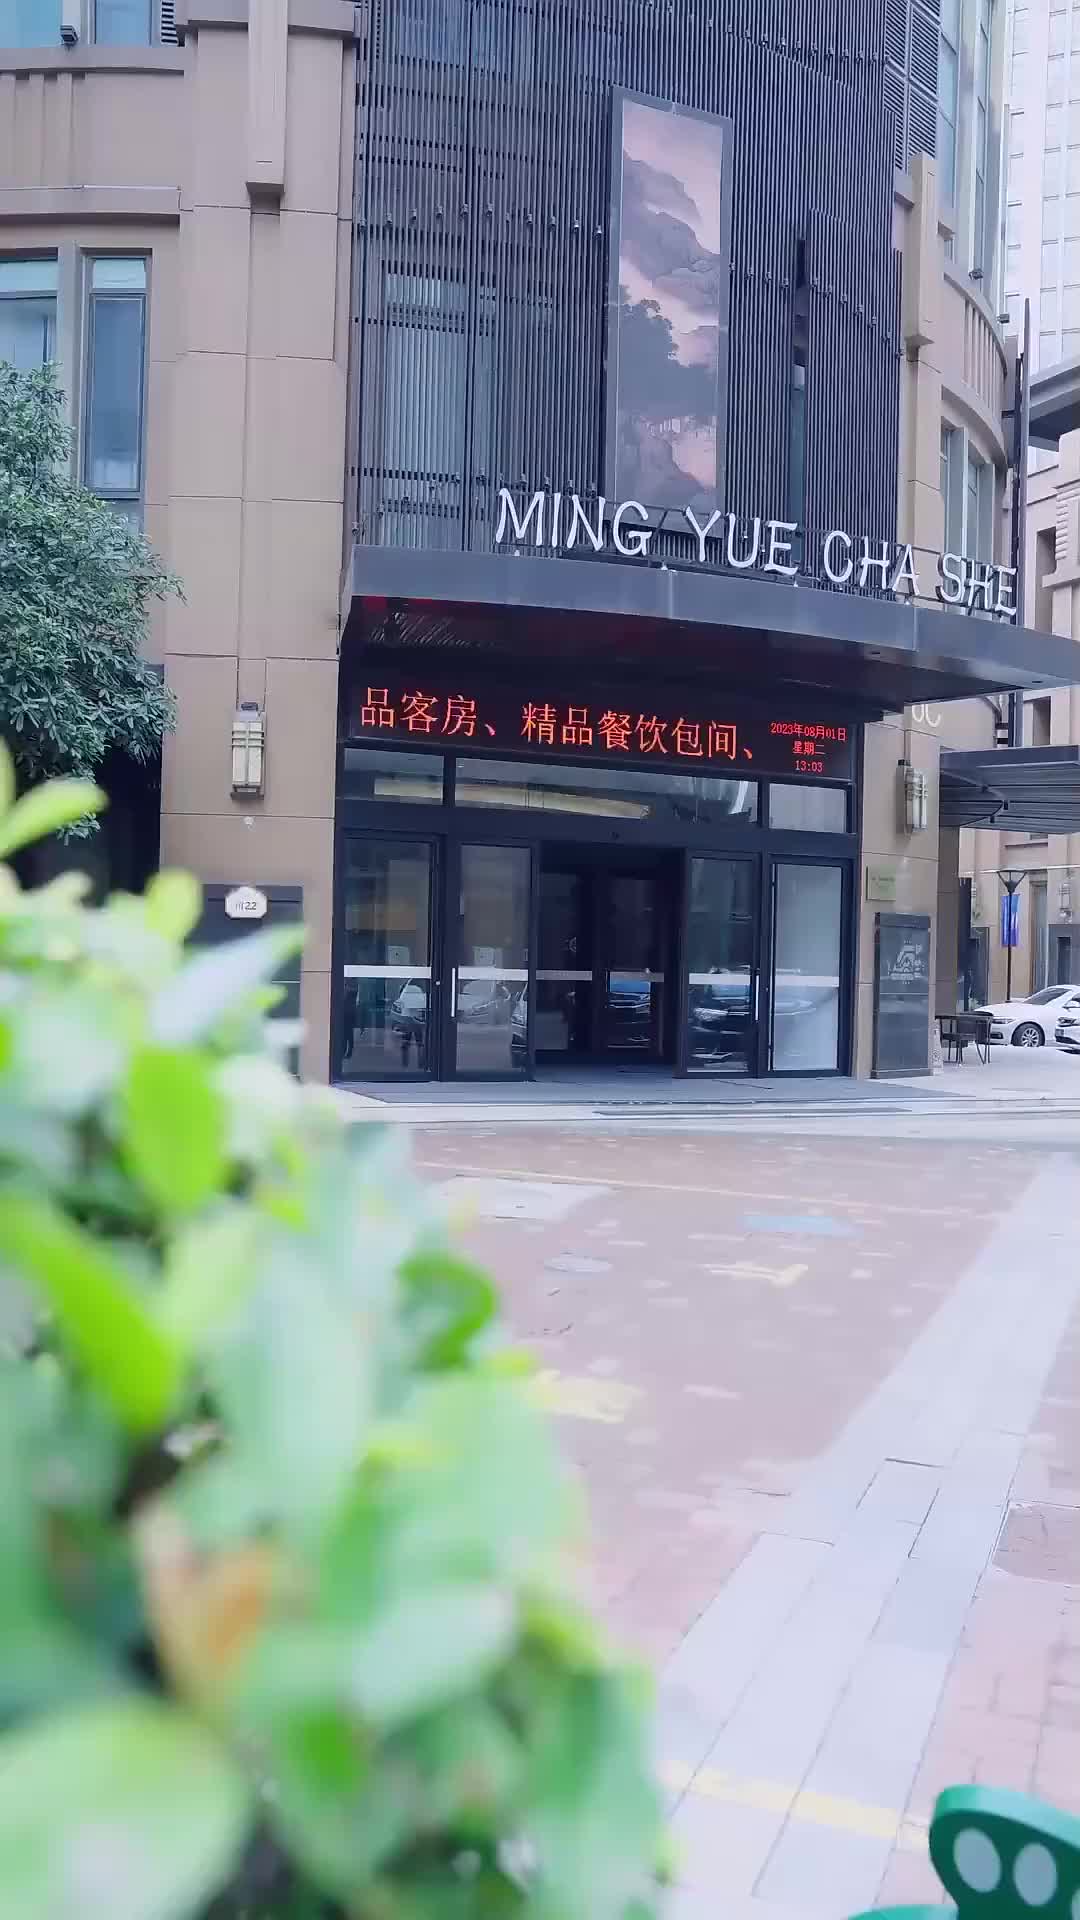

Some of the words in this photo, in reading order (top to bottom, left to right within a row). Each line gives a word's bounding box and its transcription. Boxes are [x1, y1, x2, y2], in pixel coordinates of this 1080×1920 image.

[495, 487, 653, 556] MING
[685, 506, 799, 575] YUE
[824, 530, 920, 596] CHA
[938, 552, 1017, 616] SHE
[769, 721, 847, 742] 2023年08月01日
[792, 741, 826, 756] 星期二
[795, 760, 823, 773] 13:03
